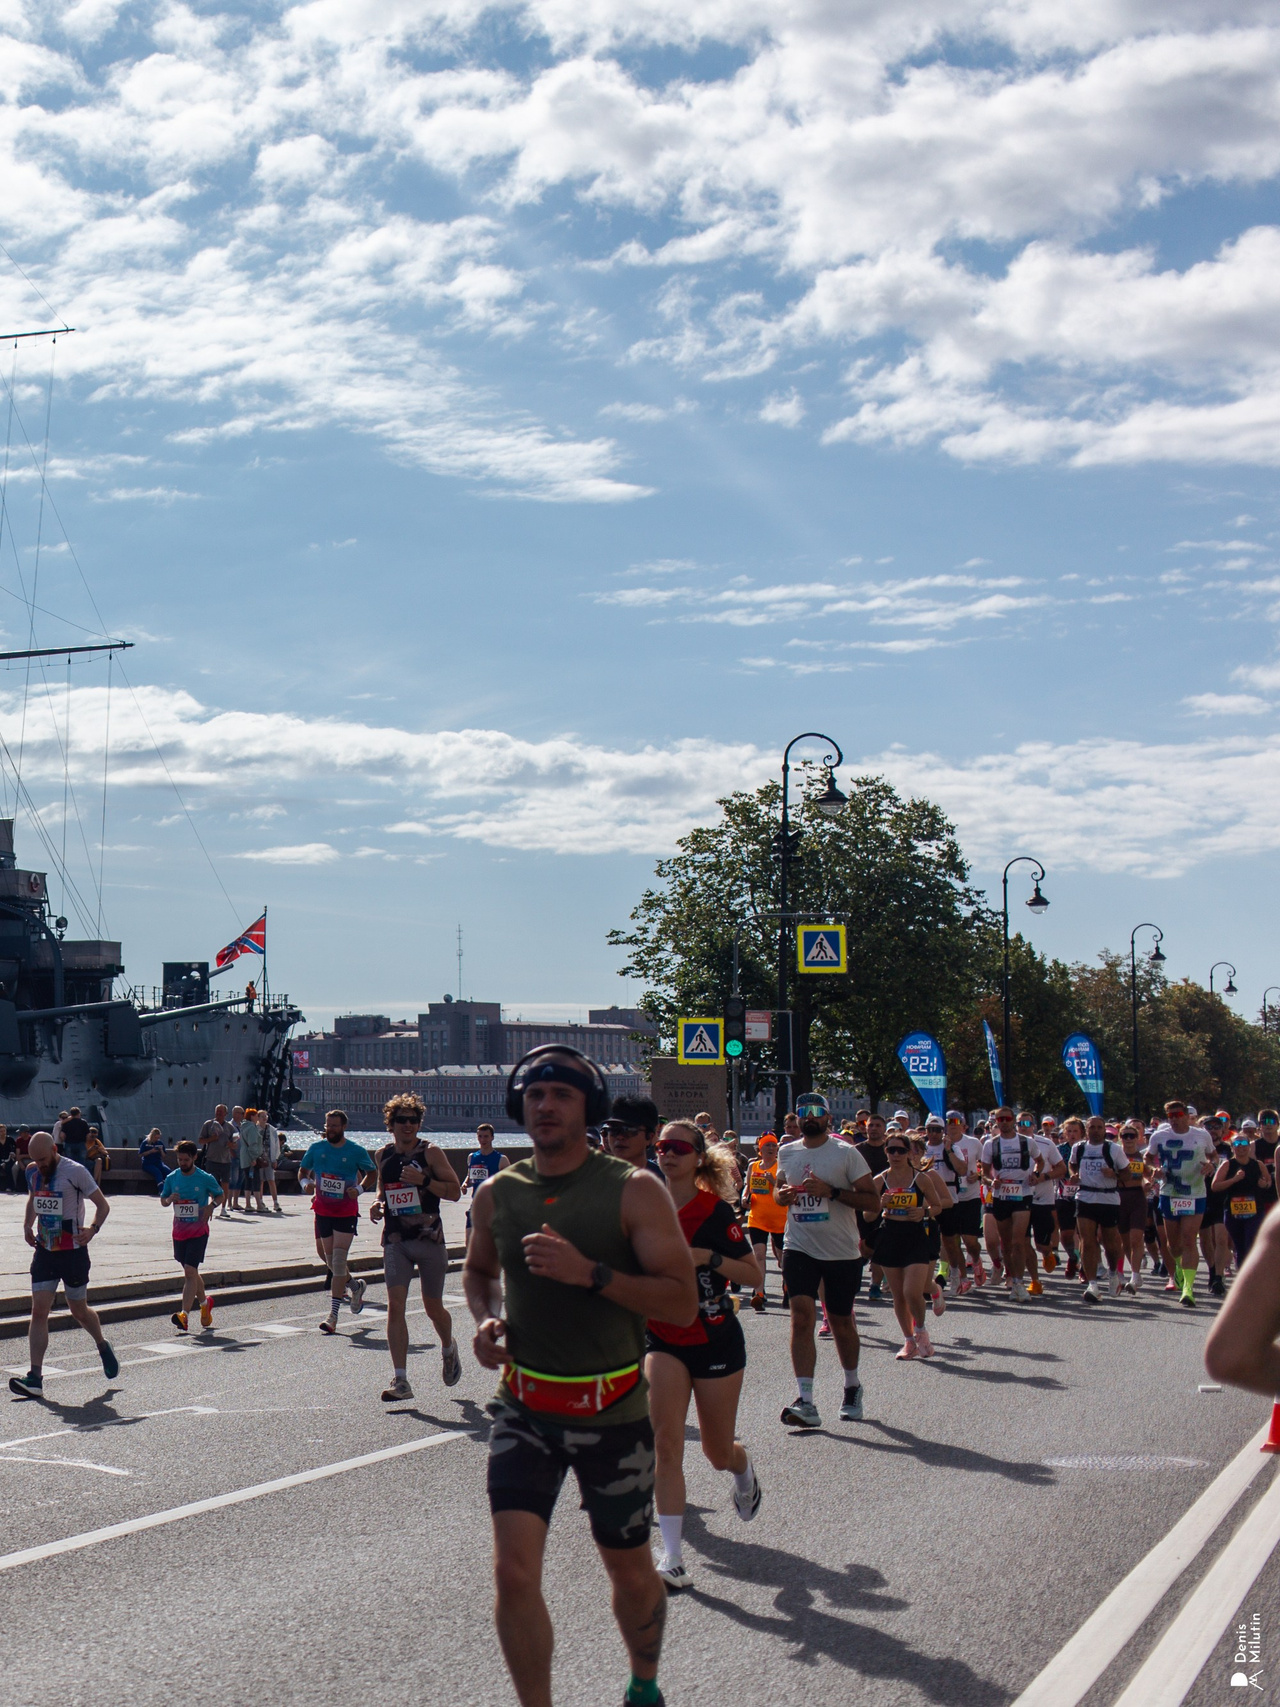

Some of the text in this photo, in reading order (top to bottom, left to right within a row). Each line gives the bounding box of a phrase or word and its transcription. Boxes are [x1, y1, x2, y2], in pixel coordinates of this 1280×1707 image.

[669, 1090, 704, 1099] АВРОРА
[323, 1179, 342, 1190] 5043
[1002, 1186, 1020, 1194] 7617
[389, 1191, 414, 1204] 7637
[794, 1195, 822, 1207] 4109
[36, 1199, 59, 1210] 5632
[1173, 1200, 1192, 1208] 7459
[1233, 1203, 1253, 1211] 5321
[179, 1205, 194, 1214] 790
